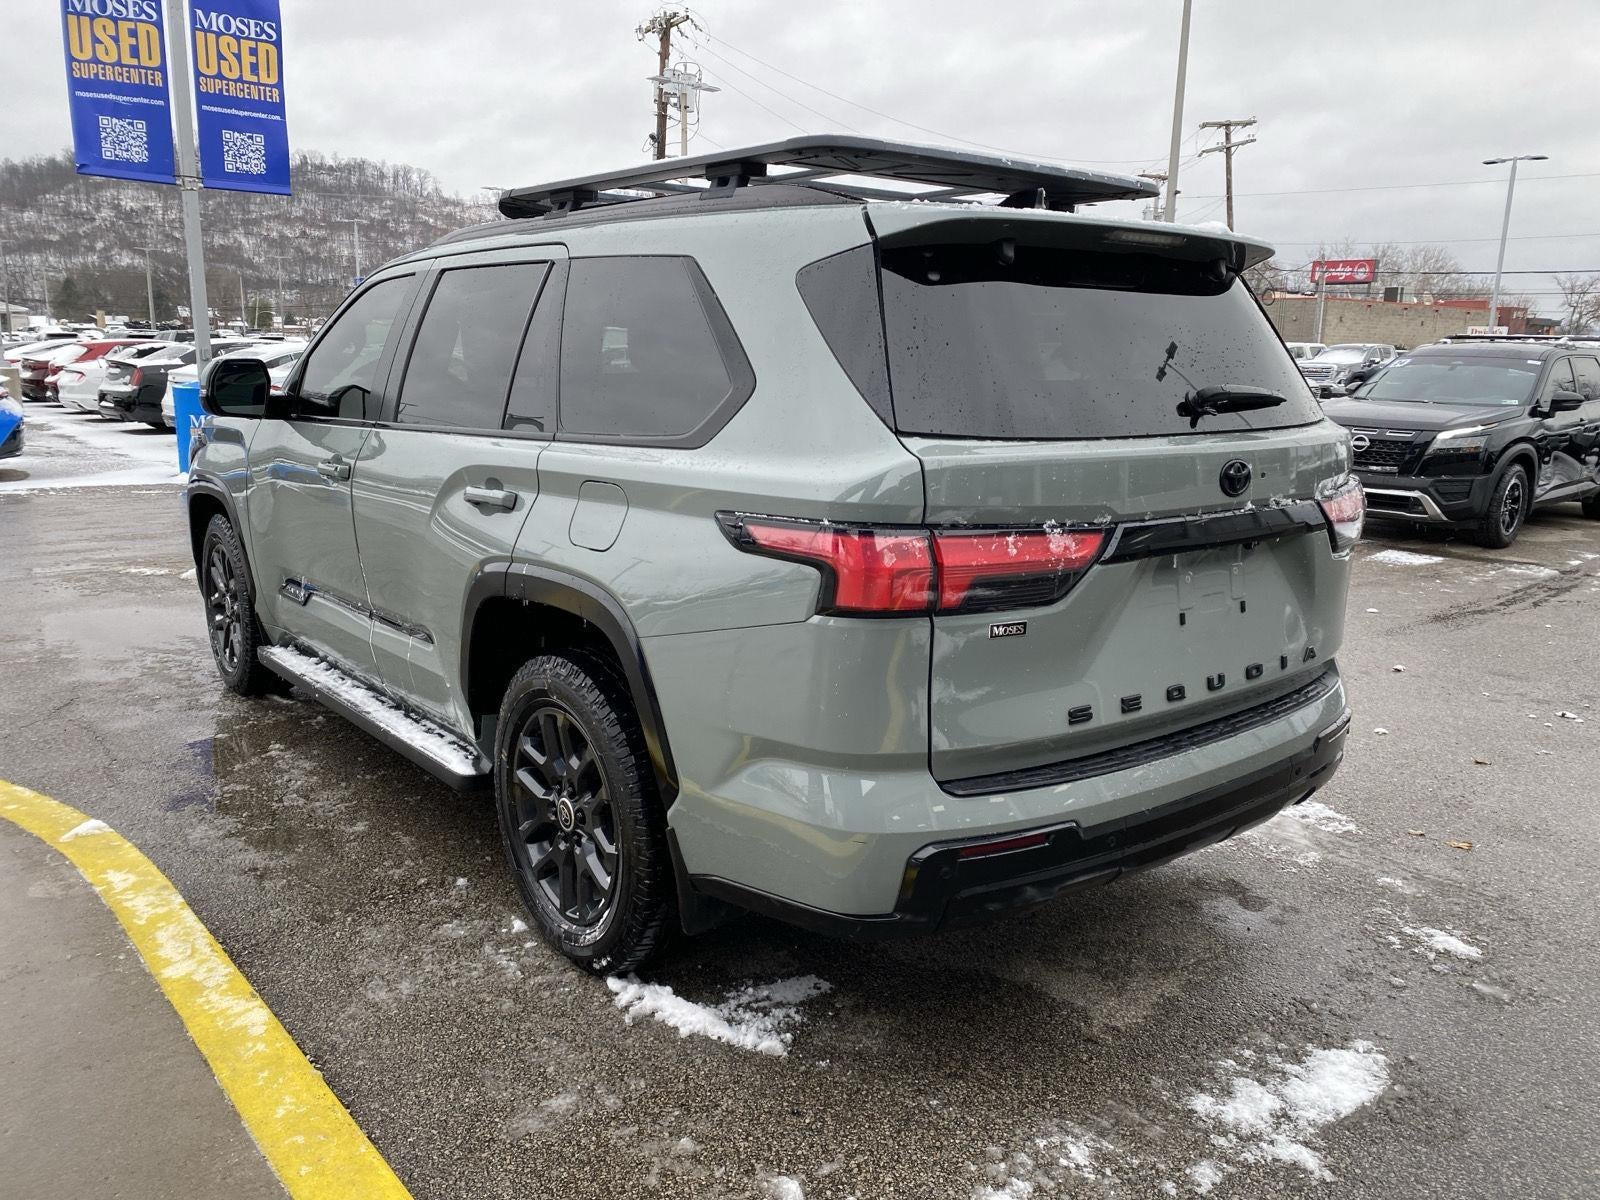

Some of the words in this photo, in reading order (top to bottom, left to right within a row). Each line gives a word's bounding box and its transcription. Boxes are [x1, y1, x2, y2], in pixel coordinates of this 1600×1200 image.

[194, 8, 277, 41] MOSES
[67, 14, 161, 67] USED
[195, 30, 279, 85] USED
[71, 61, 163, 87] SUPERCENTER
[75, 90, 165, 107] mosesusedsupercenter.com
[199, 76, 280, 103] SUPERCENTER
[201, 104, 281, 121] mosesusedsupercenter.com
[992, 624, 1025, 637] MOSES
[1067, 645, 1317, 726] SEQUOIA
